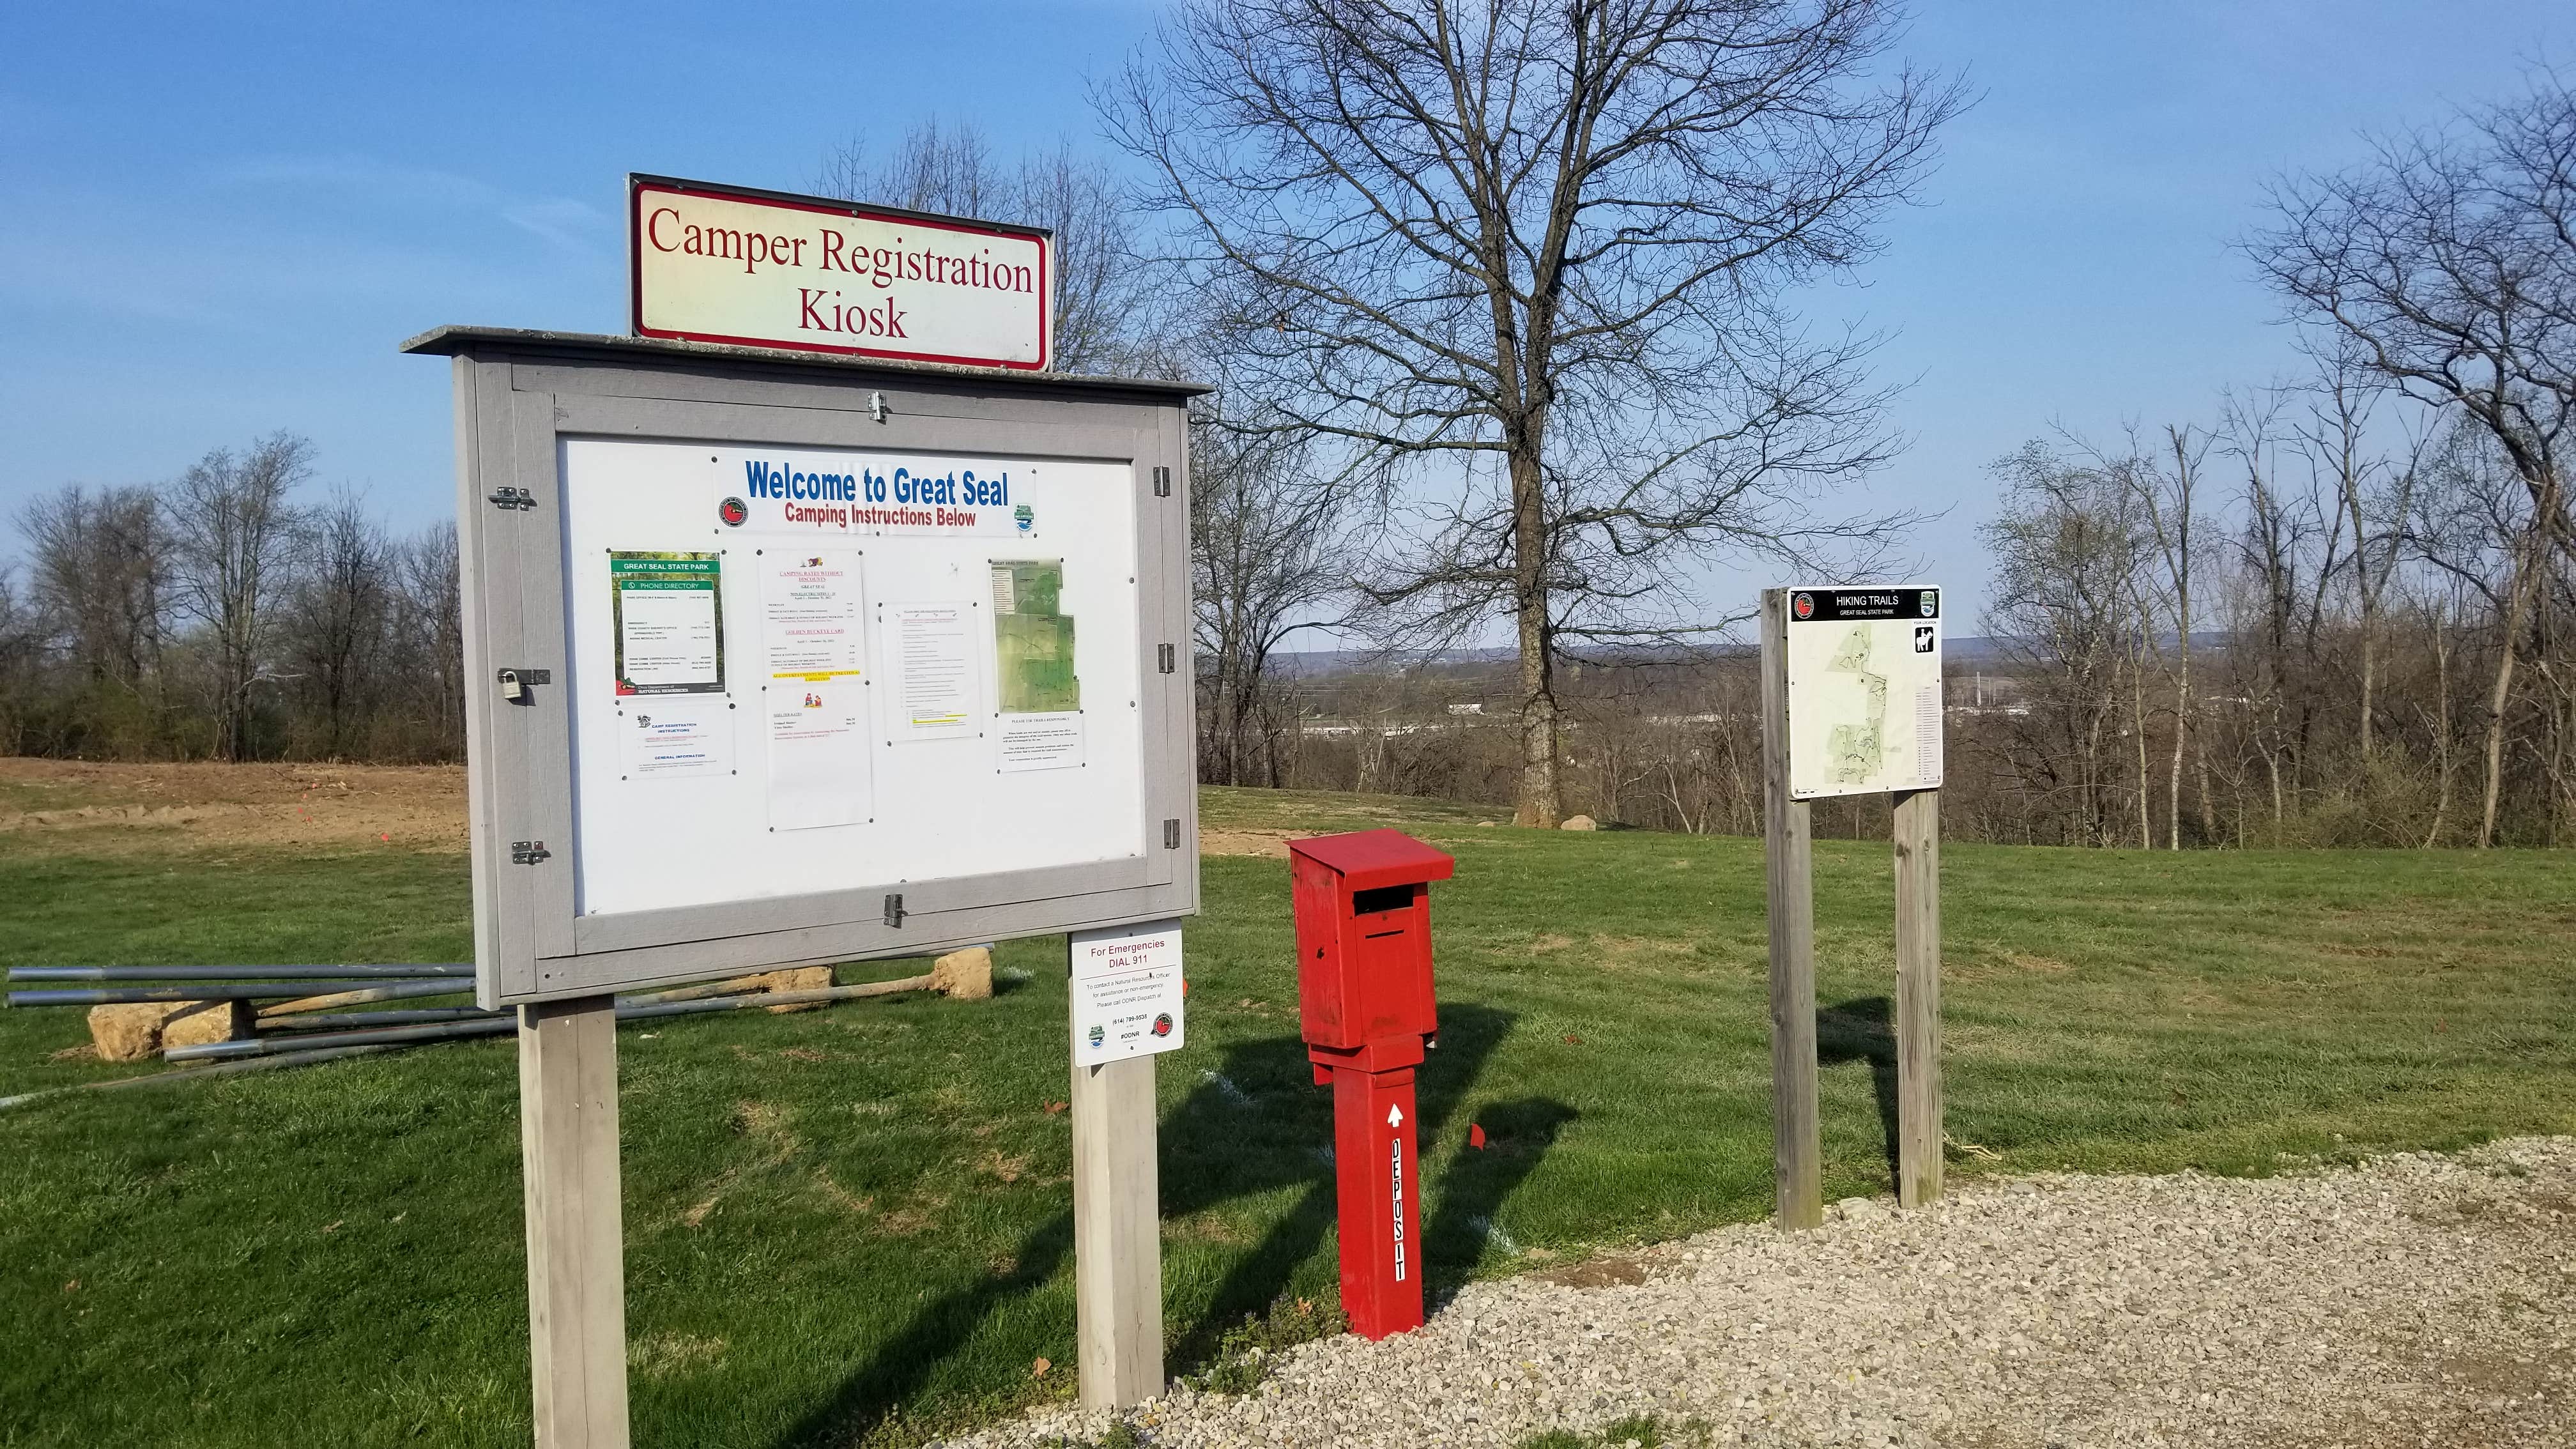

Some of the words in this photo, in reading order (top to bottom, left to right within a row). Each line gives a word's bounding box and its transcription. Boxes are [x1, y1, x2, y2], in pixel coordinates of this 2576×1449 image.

[648, 208, 808, 274] Camper
[819, 228, 1034, 293] Registration
[798, 288, 908, 339] Kiosk
[745, 461, 857, 502] Welcome
[864, 466, 887, 503] to
[894, 468, 956, 505] Great
[963, 471, 1008, 506] Seal
[785, 502, 847, 528] Camping
[852, 503, 932, 526] Instructions
[937, 507, 976, 526] Below
[1836, 595, 1867, 606] HIKING
[1868, 595, 1899, 606] TRAILS
[1091, 947, 1106, 958] For
[1108, 939, 1165, 954] Emergencies
[1109, 957, 1130, 969] DIAL
[1133, 954, 1147, 965] 911
[1094, 981, 1110, 990] contact
[1100, 988, 1124, 997] assistance
[1130, 983, 1164, 993] non-emergency
[1137, 994, 1156, 1002] Dispatch
[1112, 1017, 1124, 1026] (614)
[1121, 1031, 1140, 1040] #ODNR
[1392, 1140, 1404, 1280] DEPOSIT
